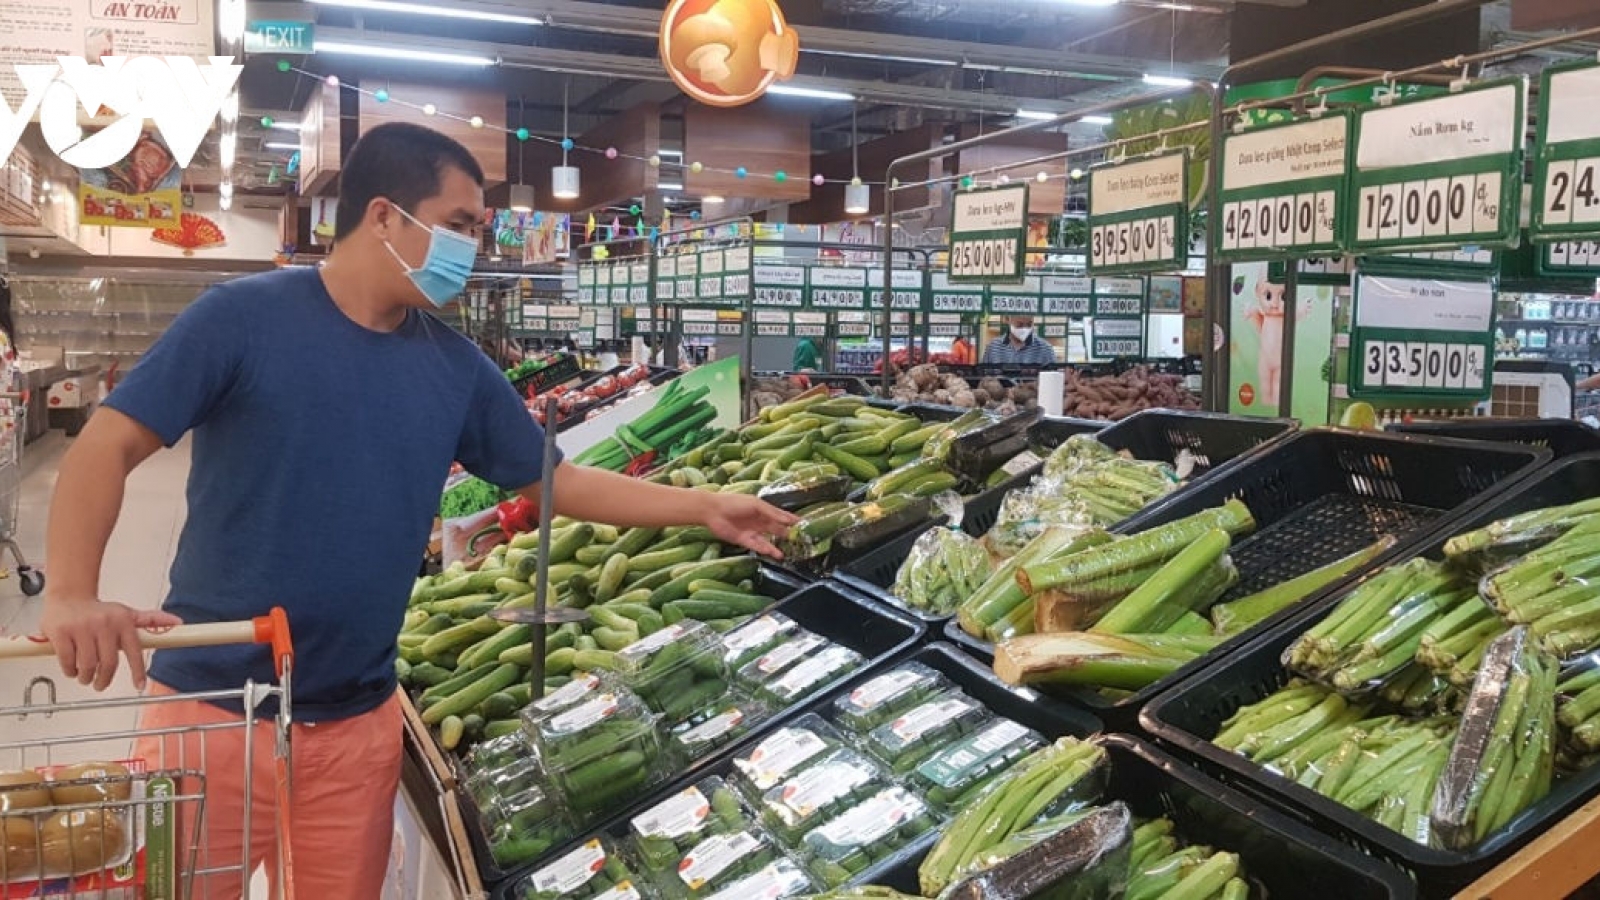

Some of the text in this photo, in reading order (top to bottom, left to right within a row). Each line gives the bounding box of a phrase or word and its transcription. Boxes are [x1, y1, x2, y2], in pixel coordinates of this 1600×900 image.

[103, 2, 130, 17] AN
[268, 26, 305, 48] EXIT
[1225, 201, 1312, 240] 42.000
[1366, 183, 1465, 229] 12.000
[1093, 222, 1155, 257] 39.500
[953, 244, 1003, 269] 25.000
[1367, 345, 1462, 378] 33.500
